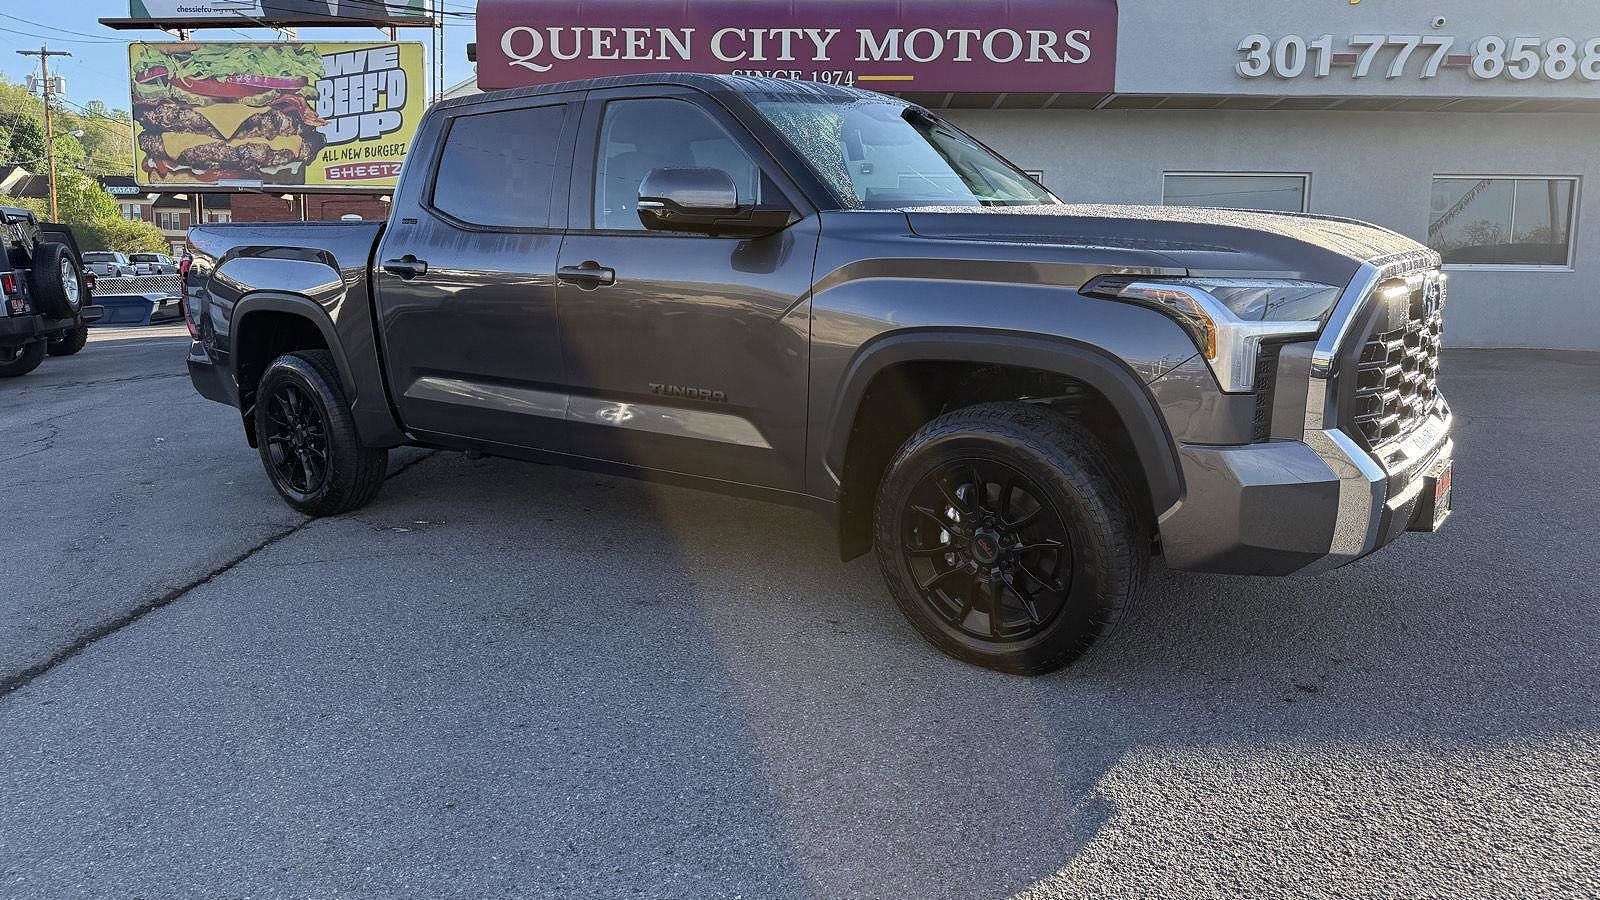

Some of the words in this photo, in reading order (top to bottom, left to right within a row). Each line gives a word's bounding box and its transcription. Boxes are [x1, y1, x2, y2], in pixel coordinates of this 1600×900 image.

[320, 45, 399, 79] WE
[500, 26, 696, 72] QUEEN
[710, 27, 841, 62] CITY
[854, 27, 1092, 64] MOTORS
[1236, 33, 1600, 81] 301-777-8588
[315, 68, 407, 119] BEEF'D
[811, 70, 855, 87] 1974
[316, 110, 403, 146] UP
[322, 150, 339, 161] ALL
[341, 147, 361, 160] NEW
[364, 143, 407, 158] BURGERZ
[330, 163, 401, 179] SHEETZ
[648, 382, 727, 403] TUNDRA
